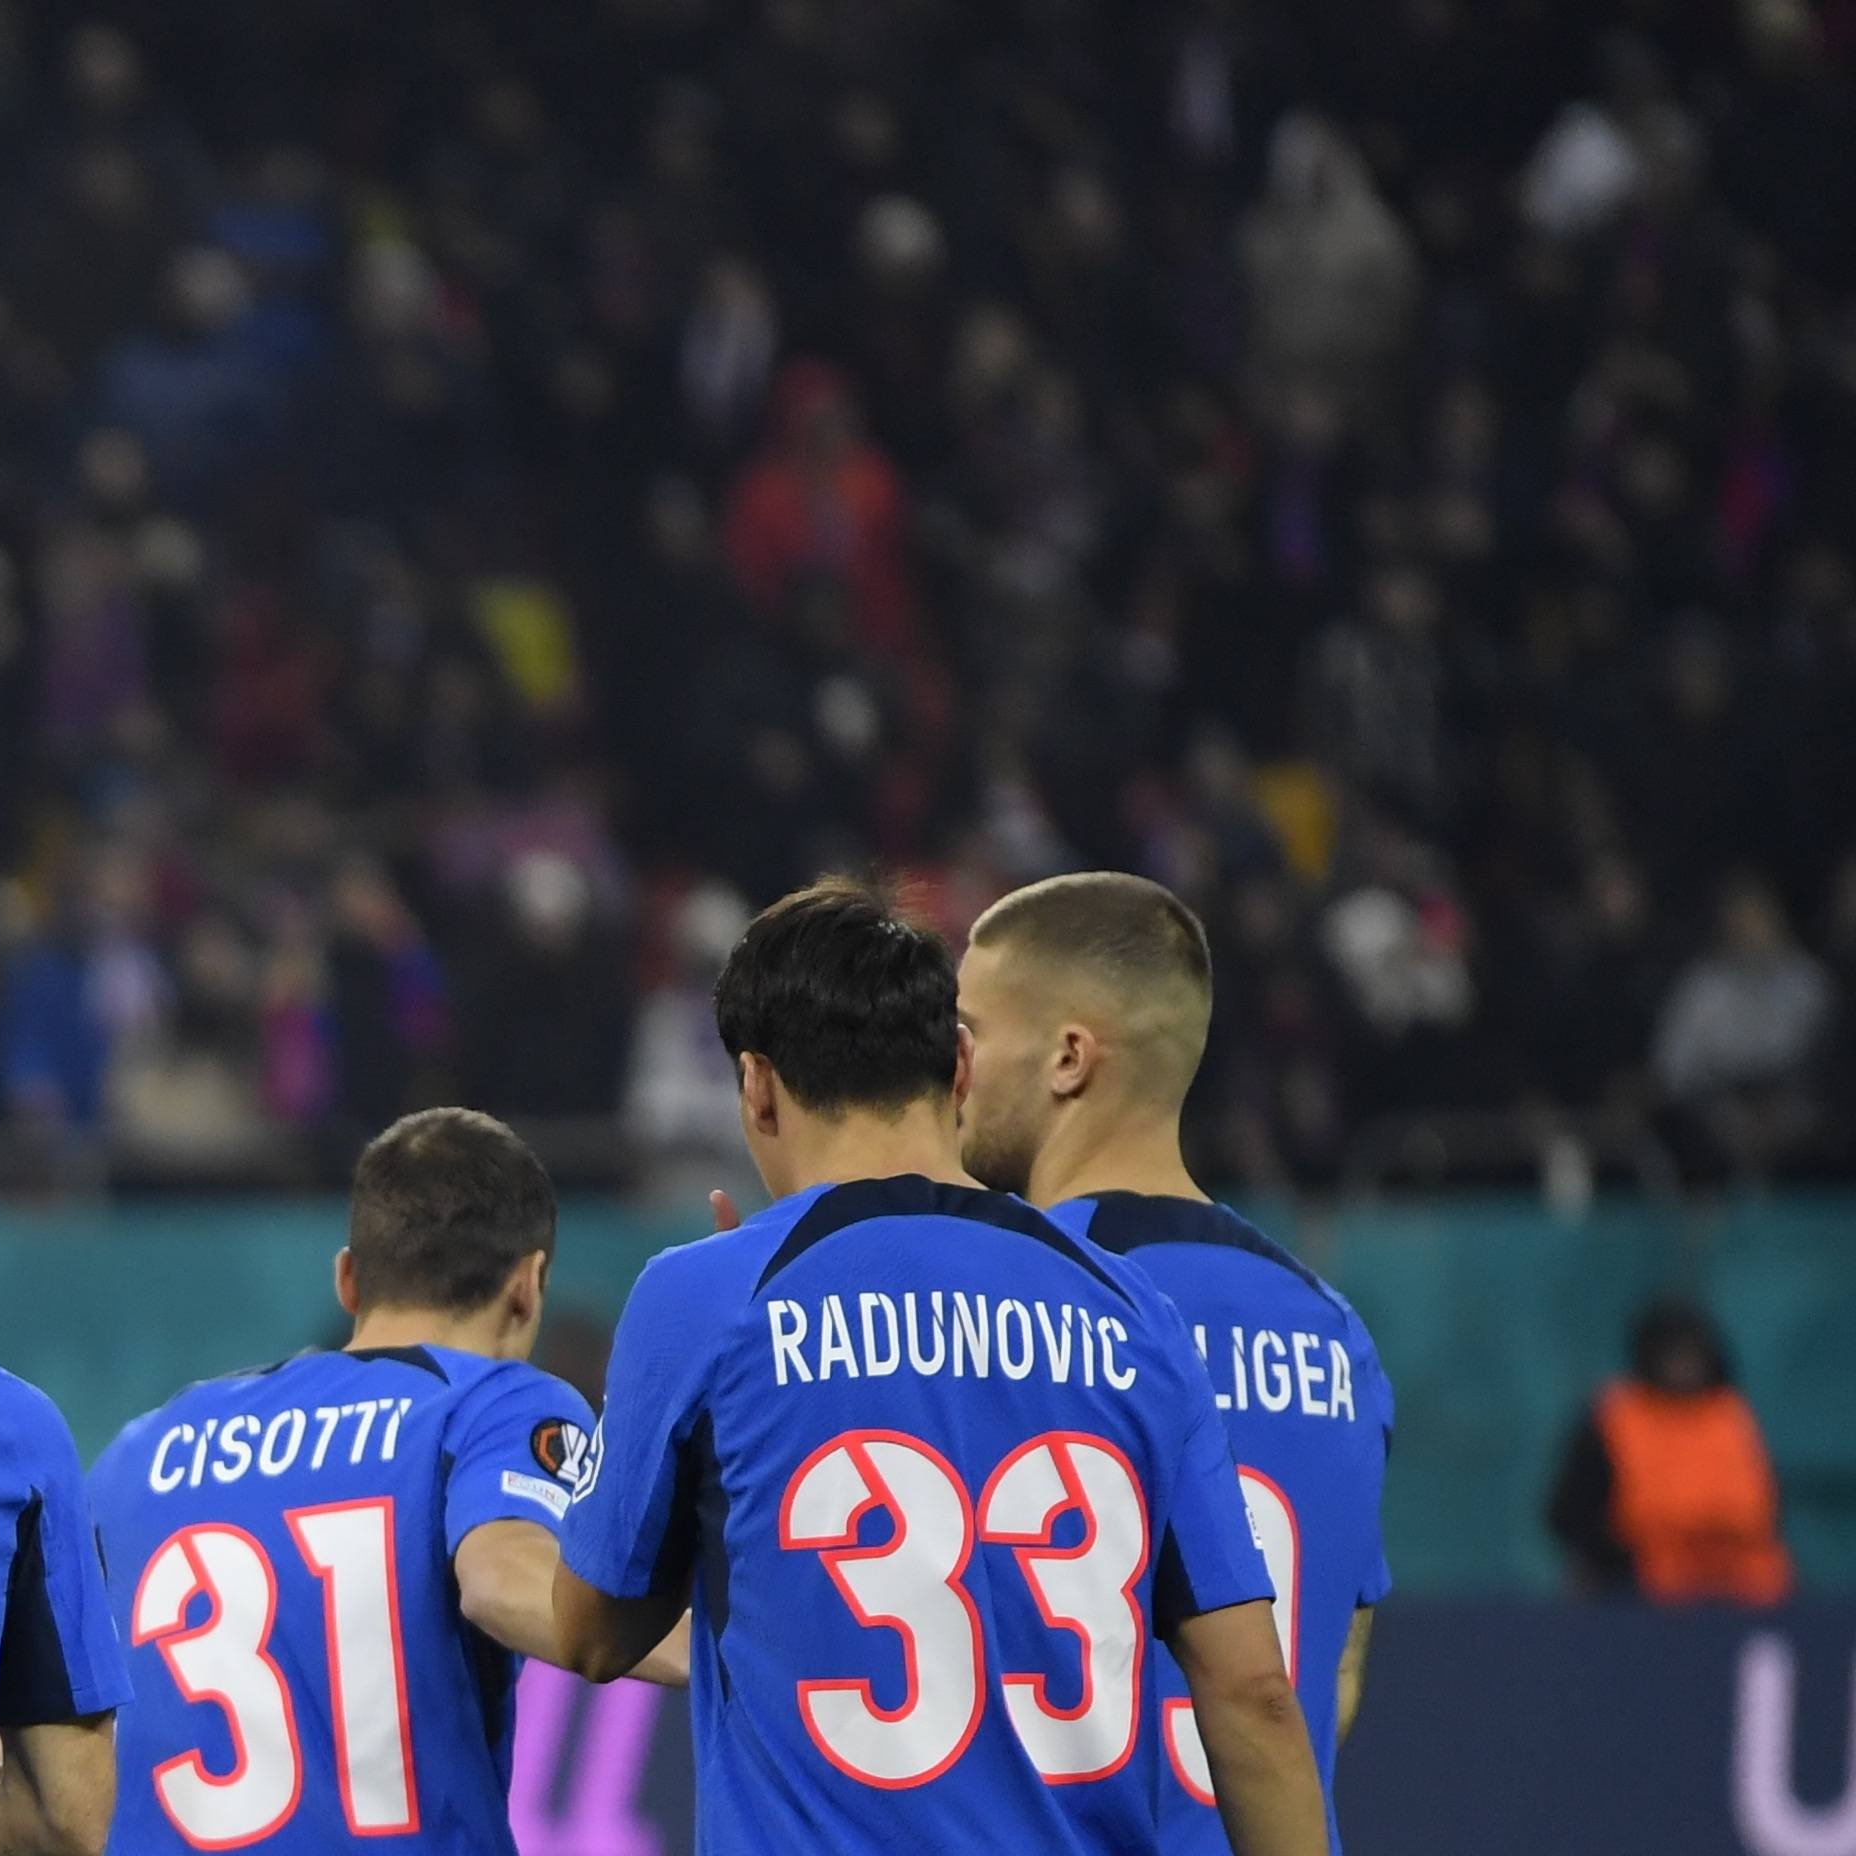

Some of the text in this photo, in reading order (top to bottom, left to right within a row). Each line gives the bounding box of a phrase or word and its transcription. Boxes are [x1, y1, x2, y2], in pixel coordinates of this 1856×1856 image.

[149, 1398, 412, 1493] CISOTTI
[767, 1291, 1137, 1390] RADUNOVIC
[132, 1496, 419, 1851] 31
[779, 1429, 1149, 1789] 33
